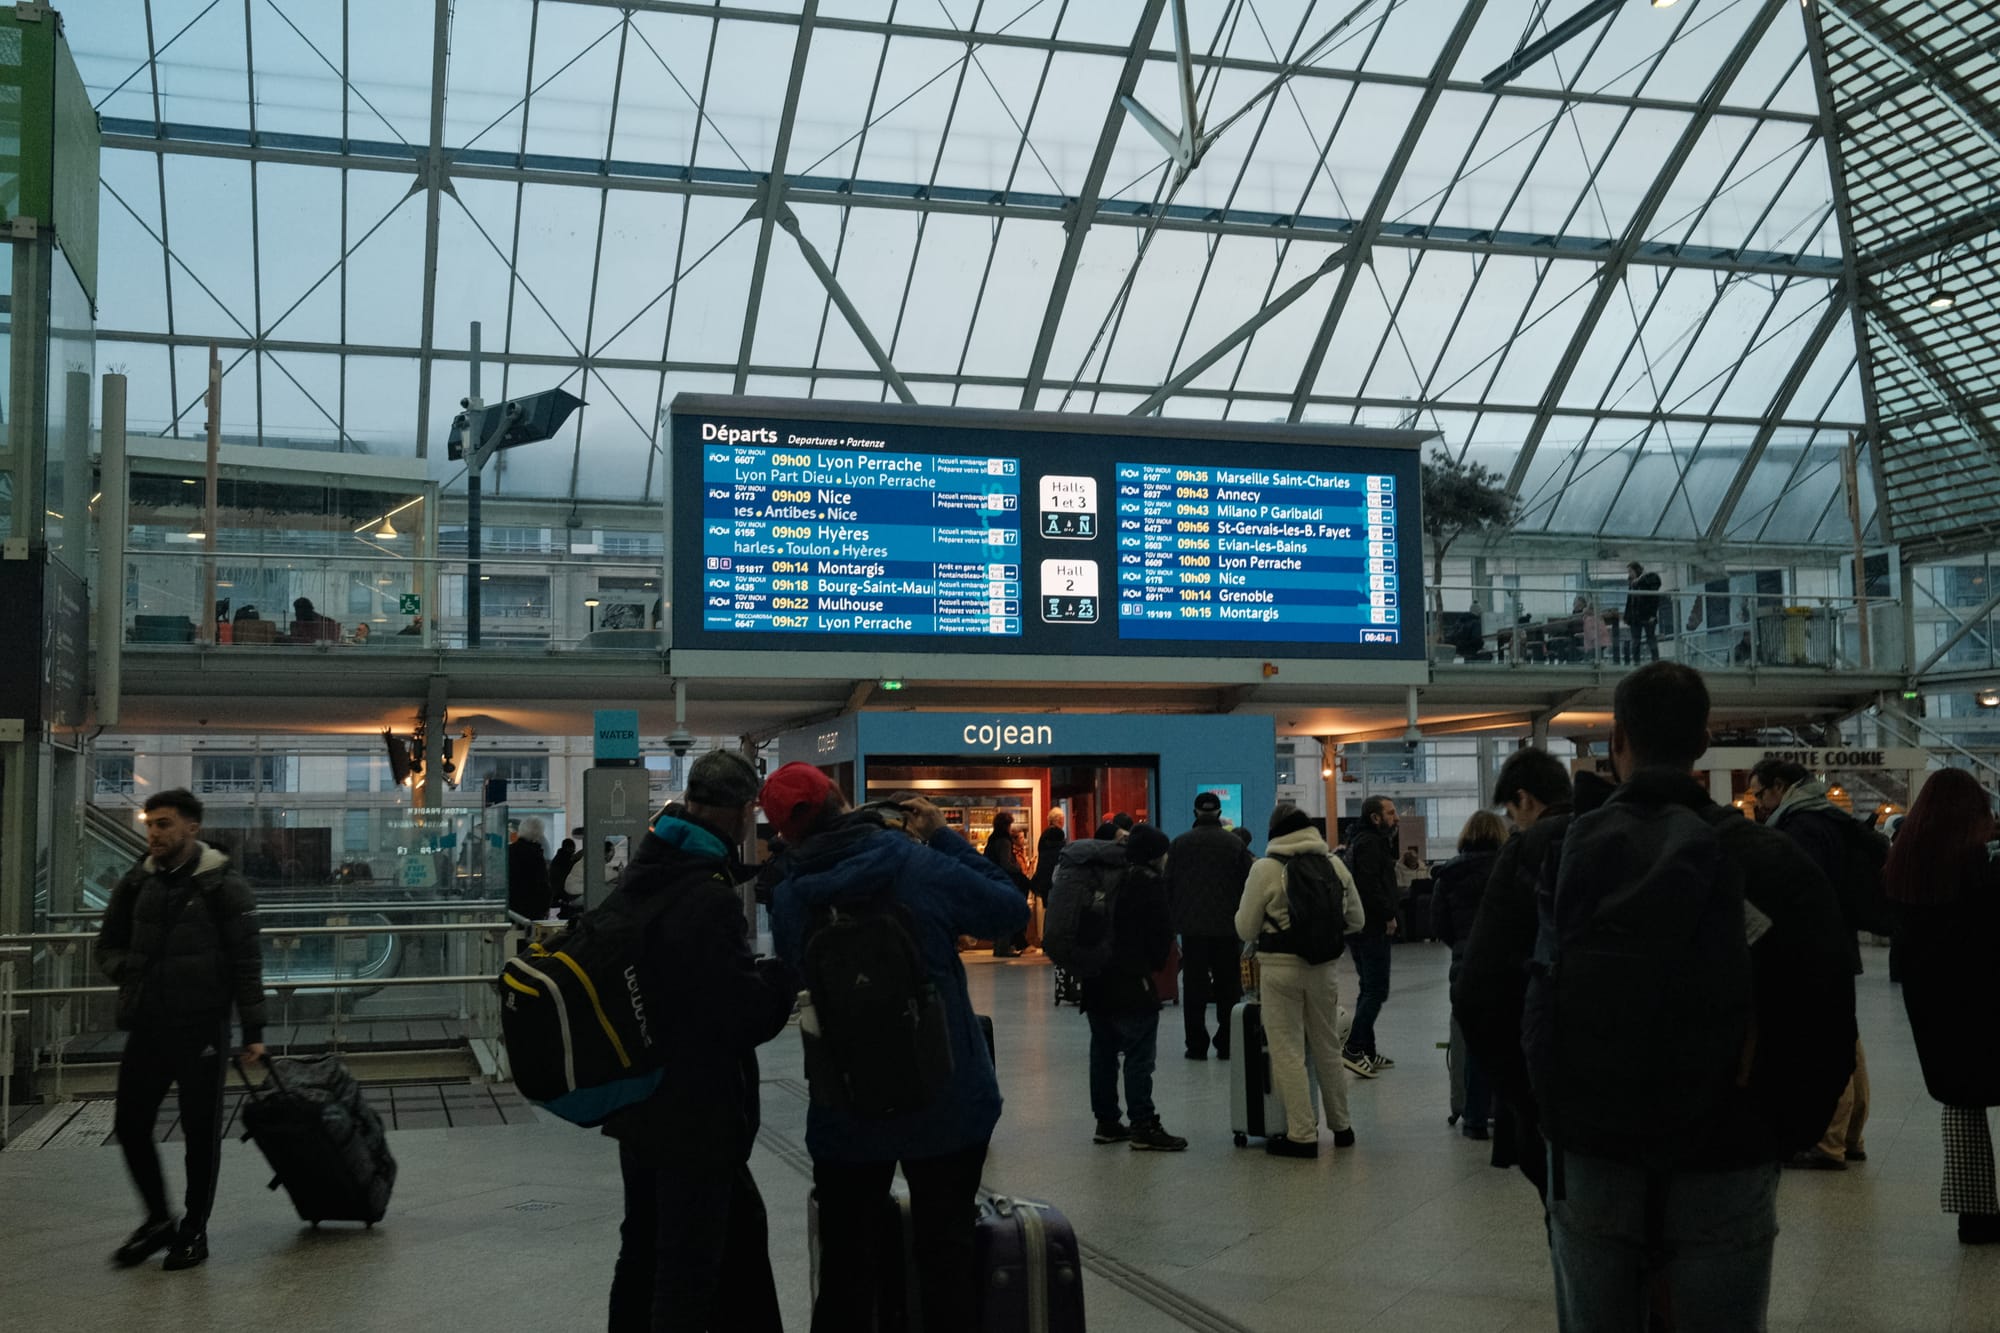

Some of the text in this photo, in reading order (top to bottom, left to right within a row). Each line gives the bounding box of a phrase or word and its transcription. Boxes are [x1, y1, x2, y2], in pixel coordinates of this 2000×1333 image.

[702, 424, 885, 448] Départs Departures Partenze
[734, 456, 755, 464] 6607
[772, 454, 811, 467] 09h00
[818, 454, 922, 471] Lyon Perrache
[1004, 464, 1014, 472] 13
[735, 468, 936, 488] Lyon Part Dieu Lyon Perrache
[1176, 471, 1208, 481] 09h35
[1216, 471, 1350, 488] Marseille Saint-Charles
[1053, 482, 1085, 493] Halls
[1177, 488, 1208, 498] 09h43
[734, 492, 755, 500] 6173
[772, 490, 811, 503] 09h09
[818, 489, 851, 504] Nice
[1216, 488, 1260, 503] Annecy
[1004, 498, 1015, 507] 17
[1052, 496, 1086, 508] 1 et 3
[765, 505, 816, 519] Antibes
[828, 508, 857, 520] Nice
[1177, 505, 1209, 515] 09h43
[1218, 505, 1323, 520] Milano P Garibaldi
[1049, 520, 1089, 532] A N
[1177, 521, 1210, 532] 09h56
[1218, 522, 1351, 540] St-Gervais-les-B. Fayet
[772, 526, 811, 539] 09h09
[818, 526, 869, 542] Hyères
[1005, 533, 1015, 542] 17
[734, 541, 888, 559] harles Toulon Hyères
[1178, 539, 1210, 549] 09h56
[1218, 538, 1307, 552] Evian-les-Bains
[772, 561, 808, 573] 09h14
[1179, 556, 1210, 566] 10h00
[1219, 556, 1301, 570] Lyon Perrache
[818, 562, 884, 578] Montargis
[1057, 566, 1082, 576] Hall
[1179, 573, 1210, 583] 10h09
[1220, 573, 1245, 584] Nice
[772, 580, 808, 591] 09h18
[1066, 580, 1074, 591] 2
[1180, 590, 1211, 600] 10h14
[1220, 590, 1273, 602] Grenoble
[772, 598, 808, 609] 09h22
[818, 597, 884, 611] Mulhouse
[1050, 604, 1093, 616] 5 23
[1180, 607, 1211, 618] 10h15
[1220, 607, 1279, 621] Montargis
[772, 616, 808, 627] 09h27
[819, 616, 912, 631] Lyon Perrache
[600, 731, 634, 739] WATER
[964, 720, 1052, 751] cojean
[1825, 752, 1885, 765] COOKIE
